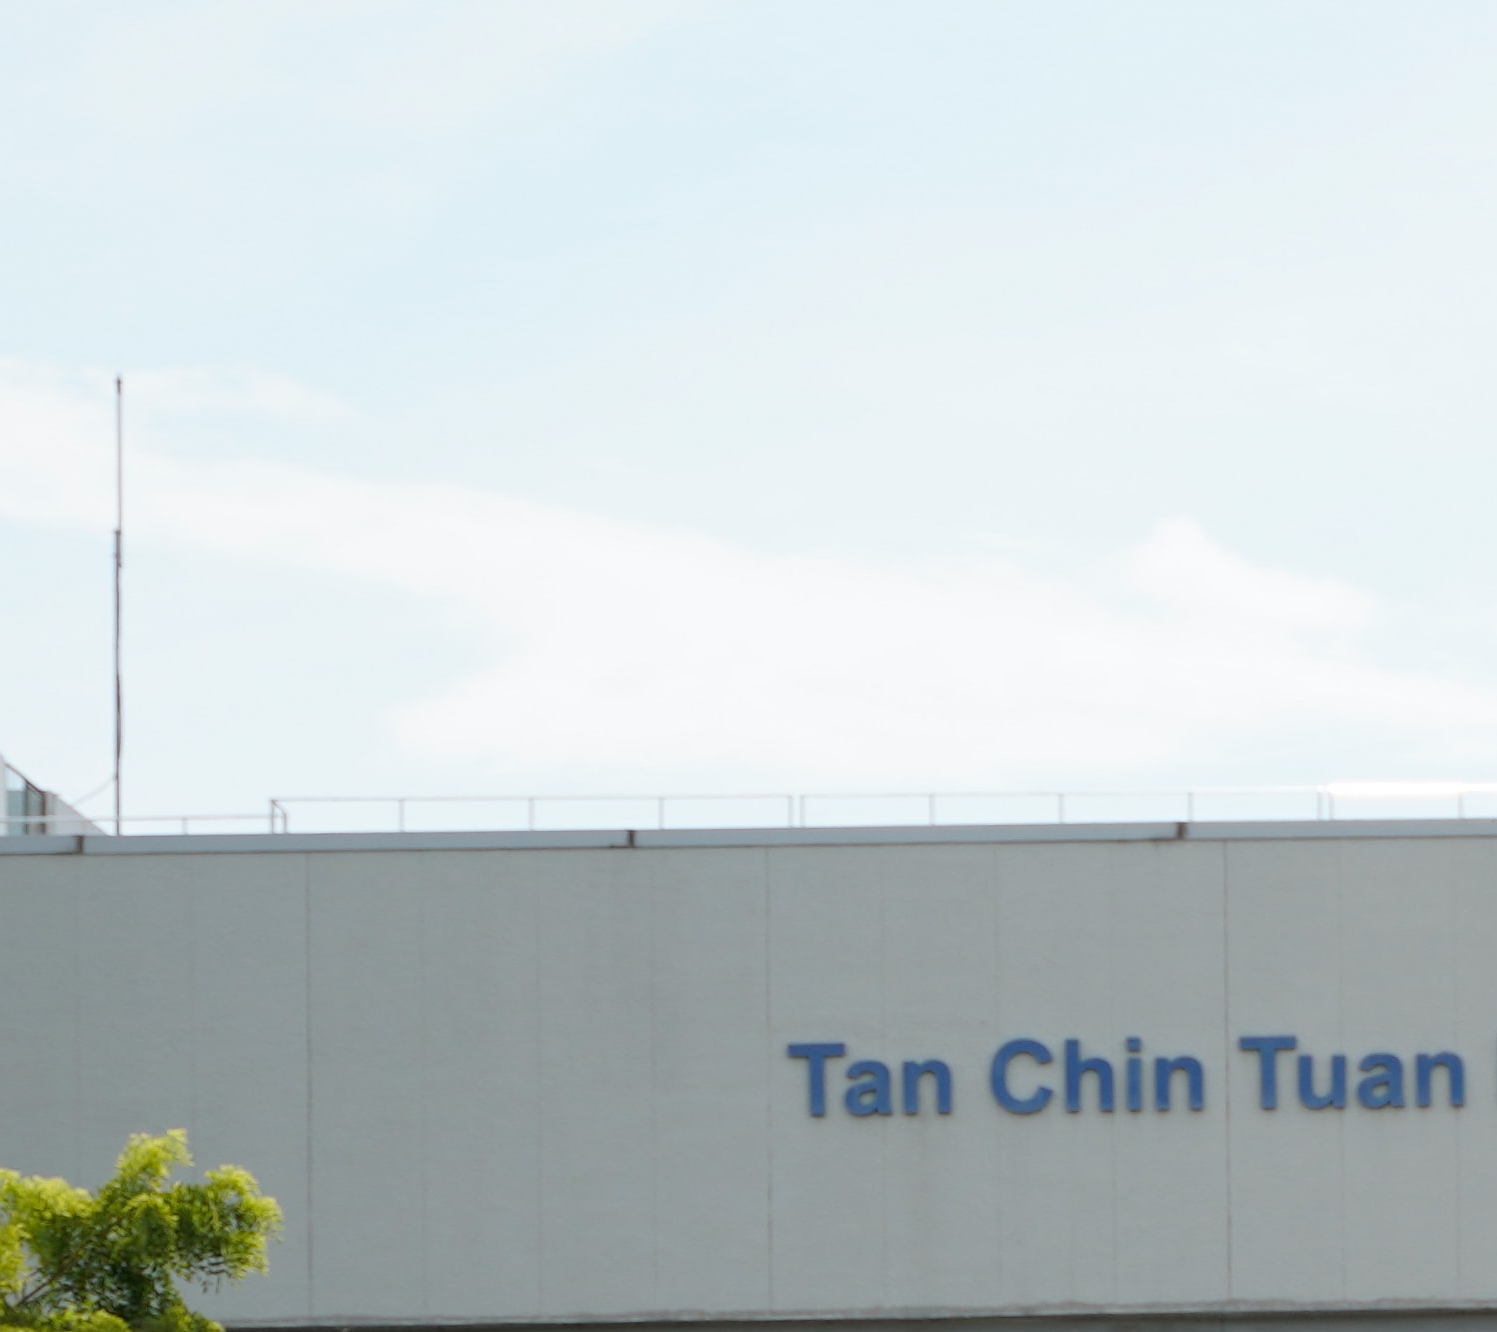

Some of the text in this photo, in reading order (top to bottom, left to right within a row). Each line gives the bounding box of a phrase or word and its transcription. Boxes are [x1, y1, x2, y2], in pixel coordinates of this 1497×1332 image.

[787, 1041, 953, 1116] Tan
[989, 1036, 1205, 1113] Chin
[1239, 1034, 1466, 1109] Tuan
